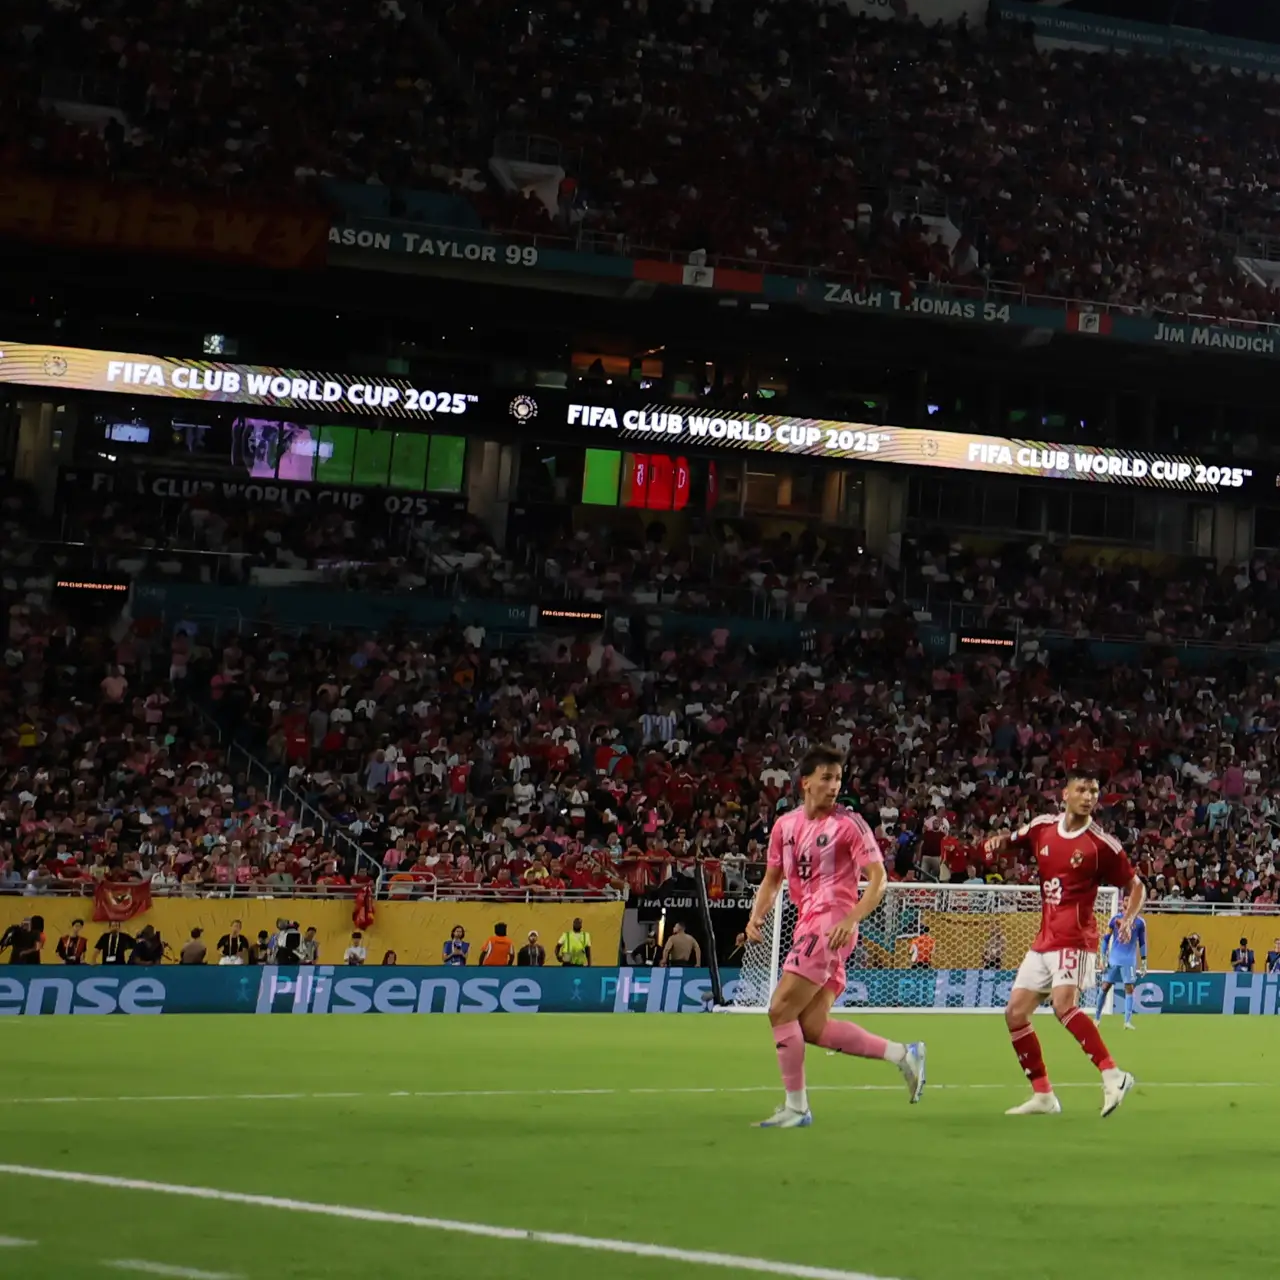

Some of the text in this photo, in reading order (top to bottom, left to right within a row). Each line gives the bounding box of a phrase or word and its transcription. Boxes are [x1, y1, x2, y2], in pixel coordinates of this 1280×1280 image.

[327, 228, 538, 268] ASON TAYLOR 99
[823, 283, 882, 308] ZACH
[983, 302, 1011, 324] 54
[1154, 323, 1185, 345] JIM
[1190, 326, 1275, 354] MANDICH
[107, 361, 165, 387] FIFA
[172, 366, 240, 393] CLUB
[247, 374, 342, 403] WORLD
[346, 384, 401, 409] CUP
[567, 403, 619, 429] FIFA
[622, 410, 683, 435] CLUB
[688, 415, 773, 443] WORLD
[775, 424, 821, 447] CUP
[968, 442, 1012, 467] FIFA
[1016, 448, 1070, 471] CLUB
[1075, 452, 1149, 478] WORLD
[1151, 460, 1193, 482] CUP
[663, 897, 736, 909] CLUB ORLD
[1058, 947, 1077, 970] 15
[0, 965, 542, 1015] ense Hisense
[1169, 981, 1211, 1006] PIF
